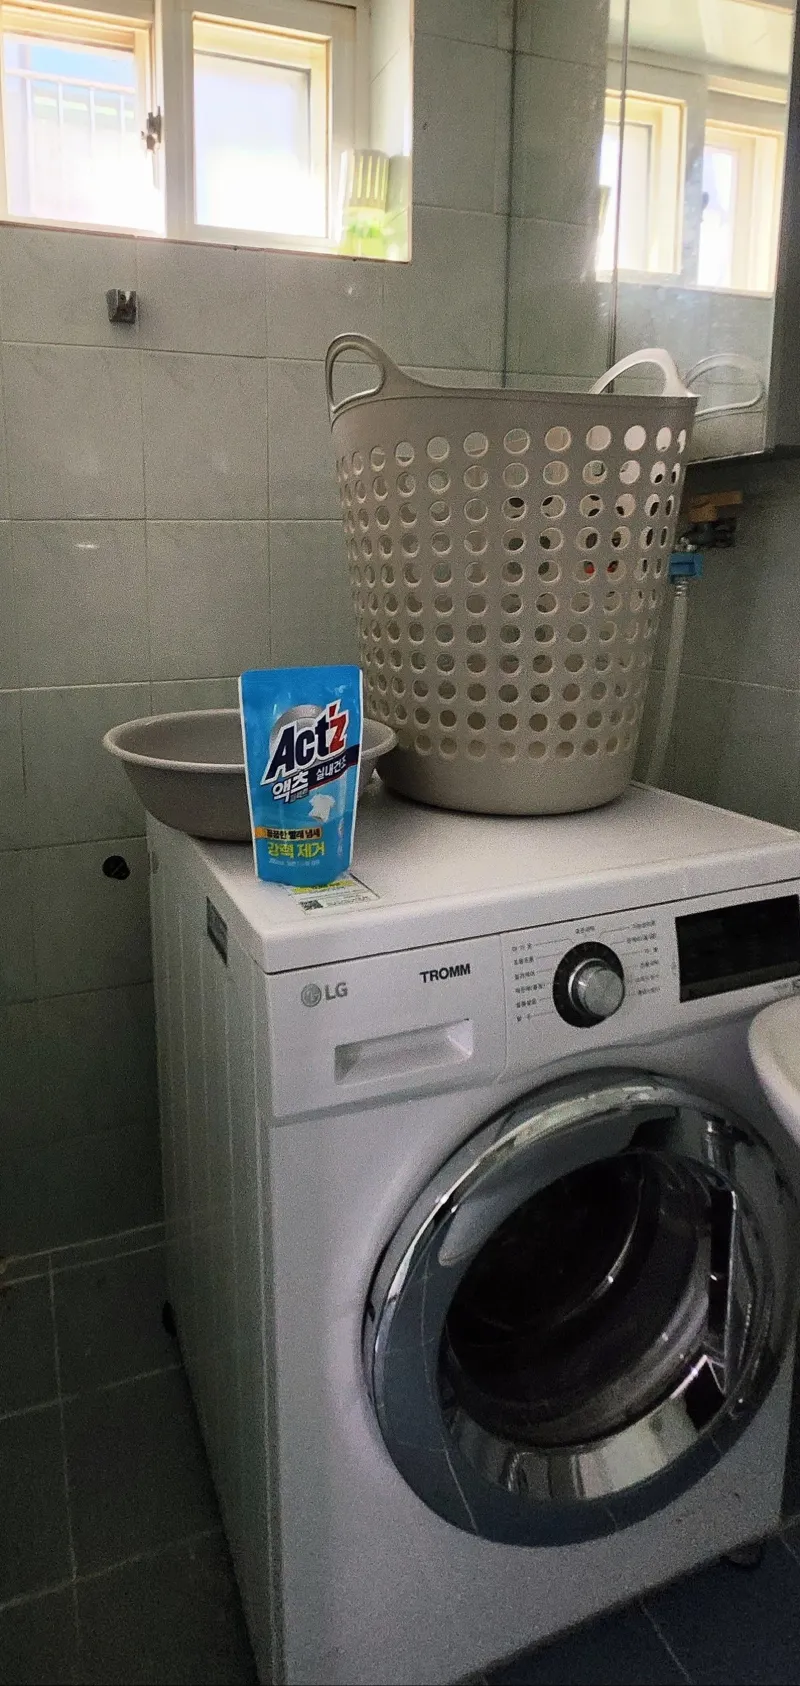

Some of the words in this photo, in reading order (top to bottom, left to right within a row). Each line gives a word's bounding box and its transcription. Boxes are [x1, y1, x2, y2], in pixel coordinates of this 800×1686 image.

[263, 702, 348, 783] Act'z
[316, 755, 347, 781] 실내건조
[272, 771, 309, 803] 액츠
[268, 842, 294, 858] 강력
[297, 841, 325, 858] 제거
[420, 964, 471, 983] TROMM
[325, 982, 348, 1000] LG
